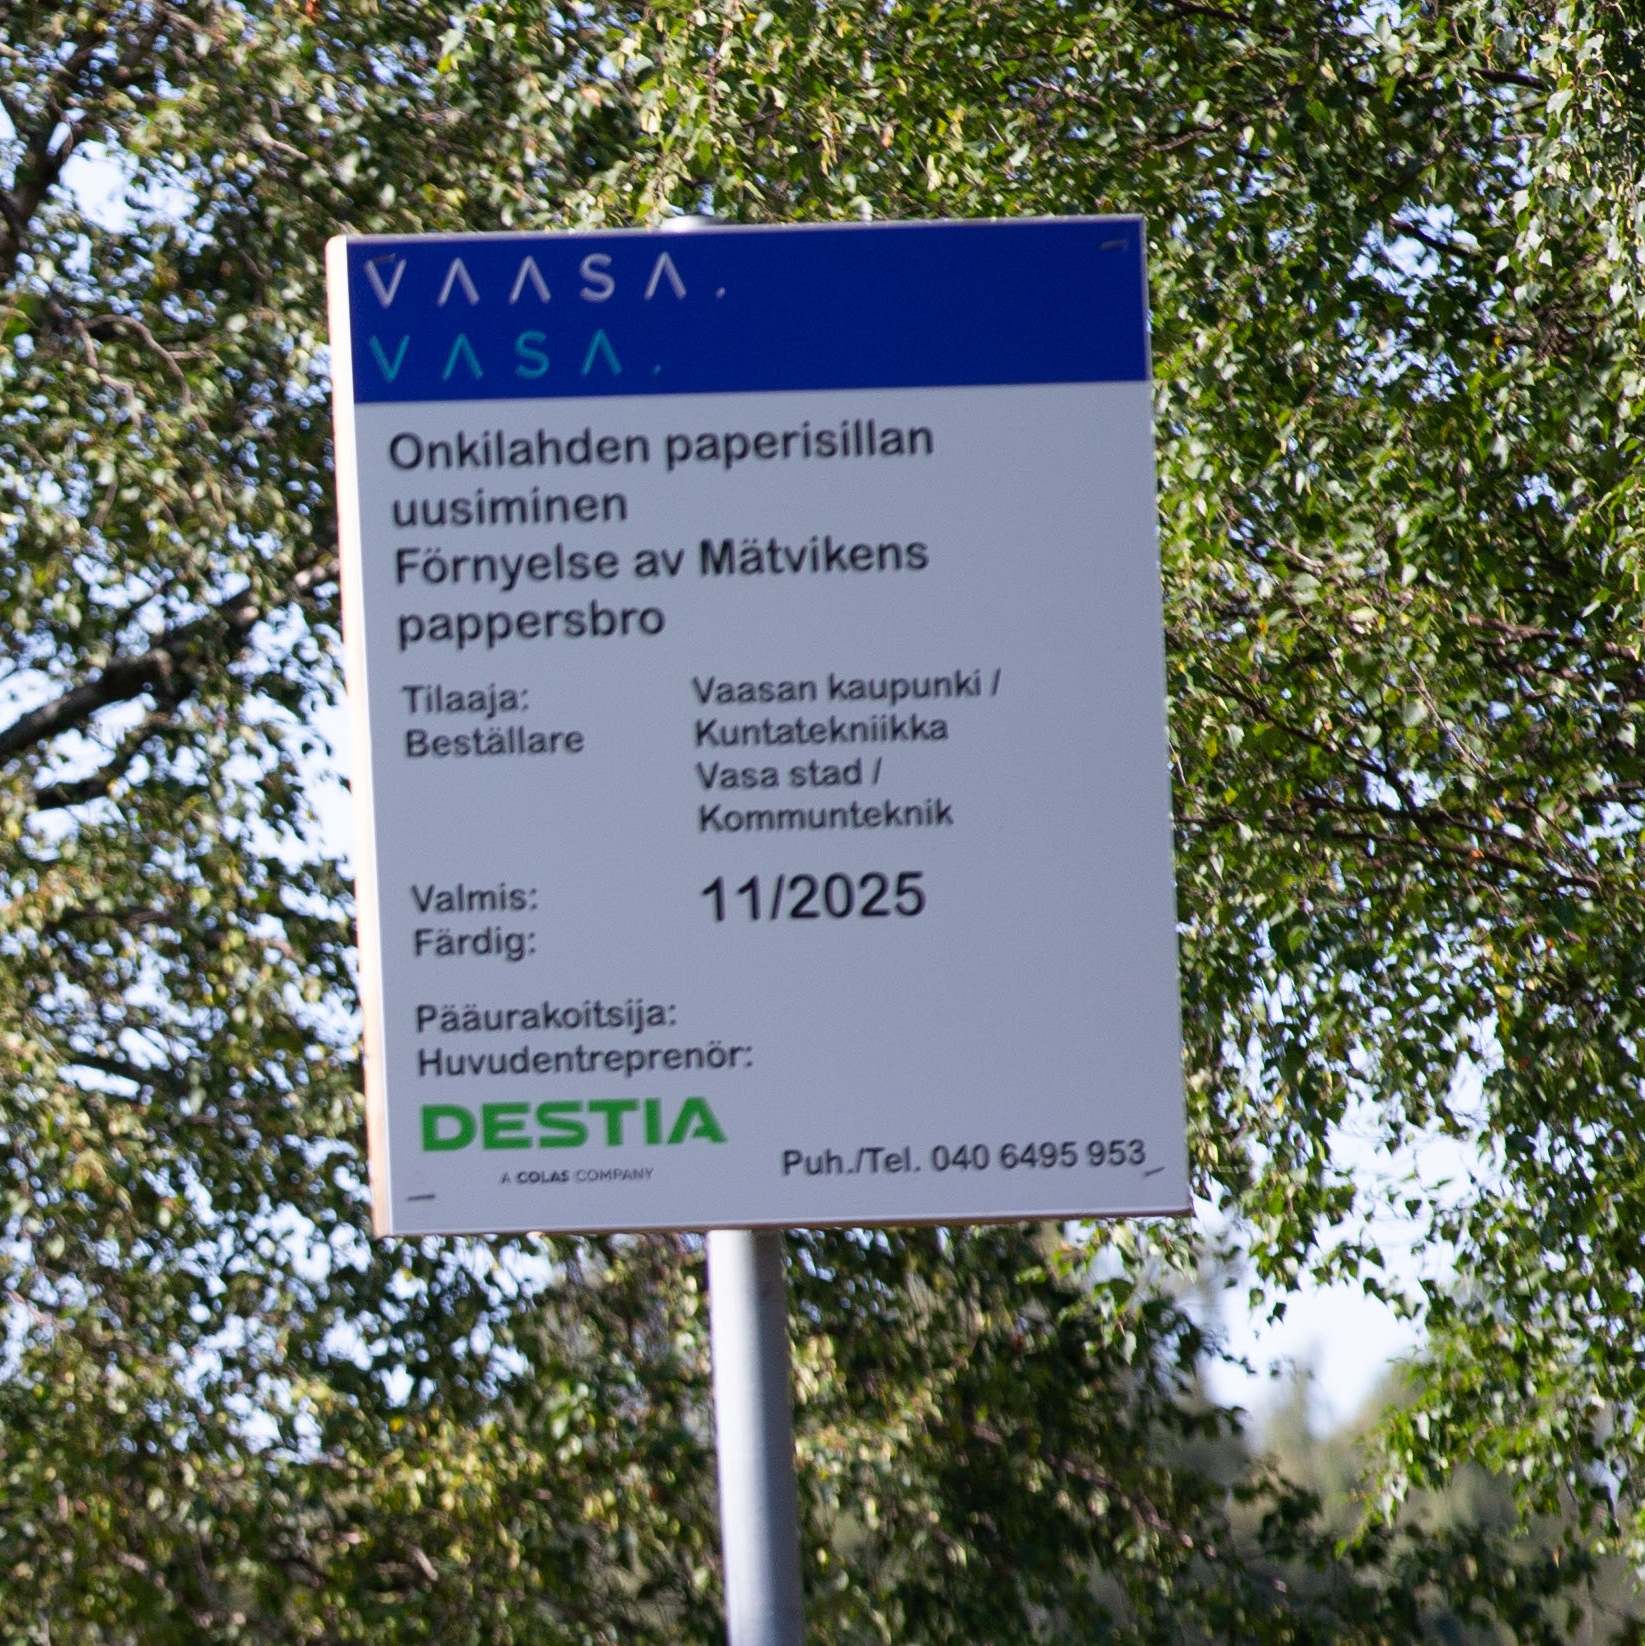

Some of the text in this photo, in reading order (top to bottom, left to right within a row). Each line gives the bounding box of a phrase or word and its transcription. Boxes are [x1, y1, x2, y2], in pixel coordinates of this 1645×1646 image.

[388, 421, 934, 471] Onkilahden paperisillan
[392, 488, 628, 528] uusiminen
[393, 533, 929, 590] Förnyelse av Mätvikens
[398, 600, 665, 651] pappersbro
[403, 684, 530, 719] Tilaaja:
[693, 674, 817, 706] Vaasan
[827, 670, 982, 709] kaupunki
[405, 726, 584, 758] Beställare
[695, 715, 949, 747] Kuntatekniikka
[696, 760, 779, 790] Vasa
[789, 758, 863, 788] stad
[699, 801, 954, 833] Kommunteknik
[412, 882, 538, 914] Valmis:
[701, 871, 927, 924] 11/2025
[414, 927, 538, 962] Färdig:
[415, 1000, 677, 1036] Pääurakoitsija:
[417, 1041, 753, 1079] Huvudentreprenör:
[421, 1097, 727, 1152] DESTIA
[516, 1170, 569, 1184] COLAS
[576, 1168, 654, 1182] COMPANY
[782, 1139, 1146, 1177] Puh./Tel. 040 6495 953
